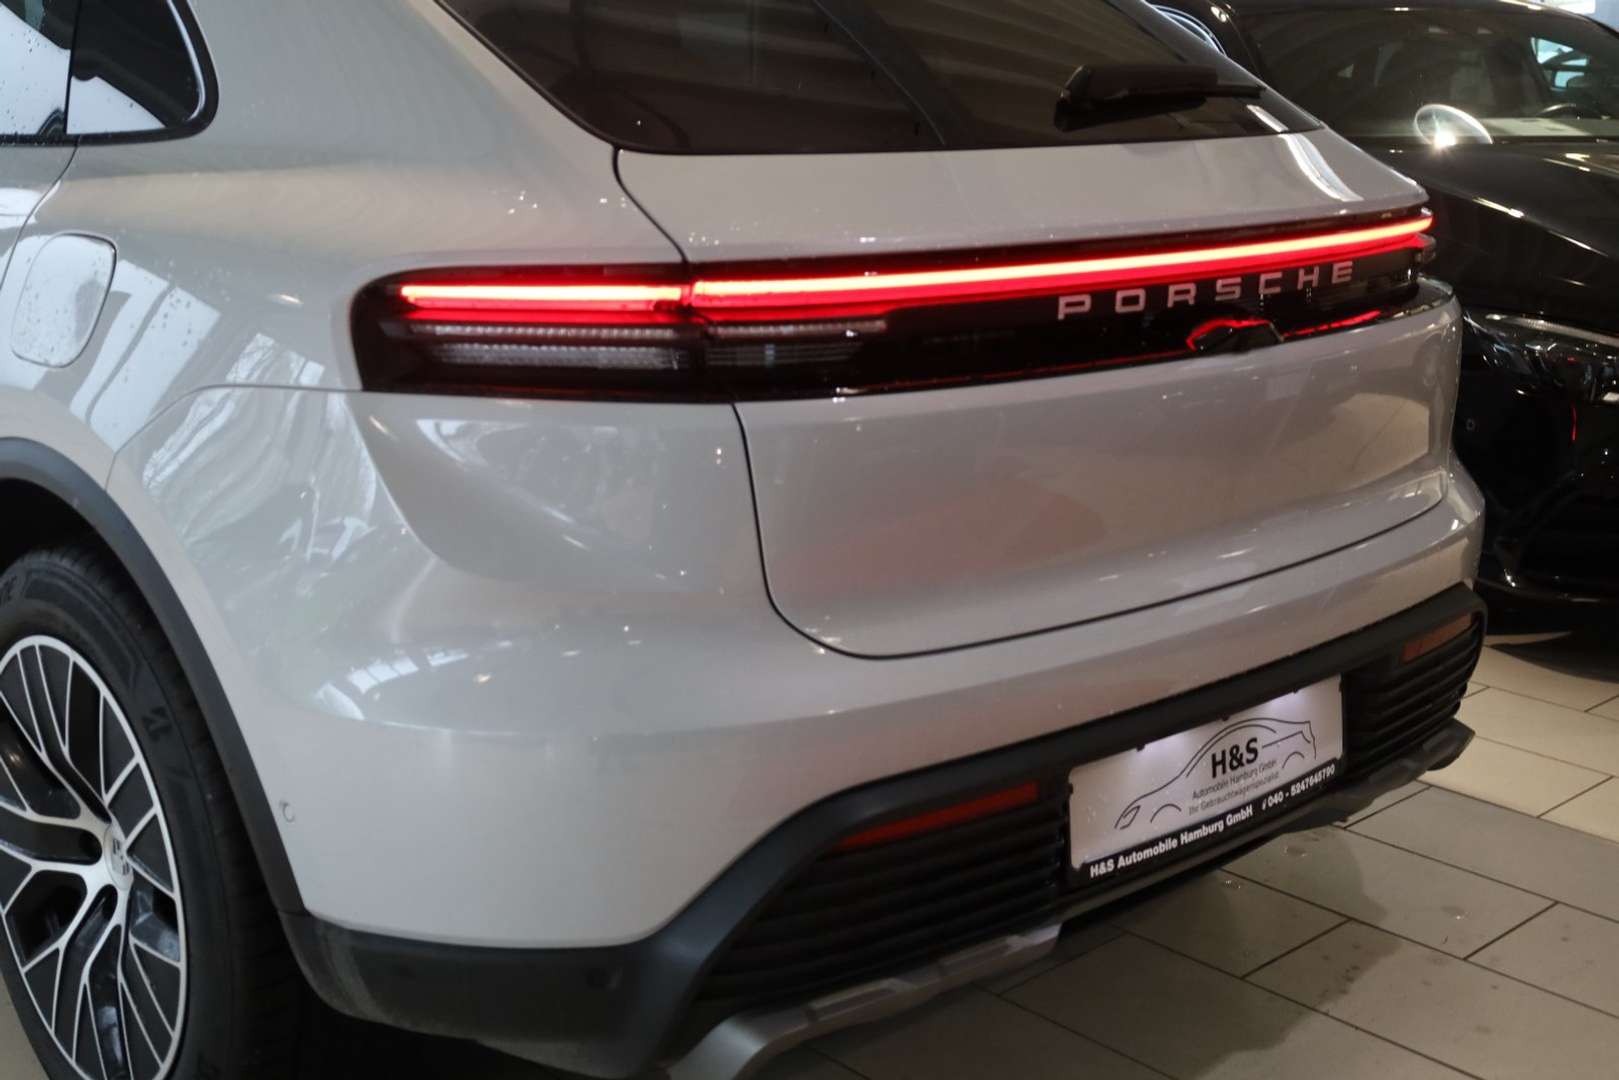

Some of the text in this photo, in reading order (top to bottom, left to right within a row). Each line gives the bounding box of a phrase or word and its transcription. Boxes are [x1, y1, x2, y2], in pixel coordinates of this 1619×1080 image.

[1057, 260, 1353, 320] PORSCHE
[1211, 737, 1259, 778] H&S
[1089, 858, 1115, 878] H&S
[1117, 837, 1178, 869] Automobile
[1179, 820, 1225, 845] Hamburg
[1226, 804, 1253, 826] GmbH
[1267, 791, 1284, 807] 040
